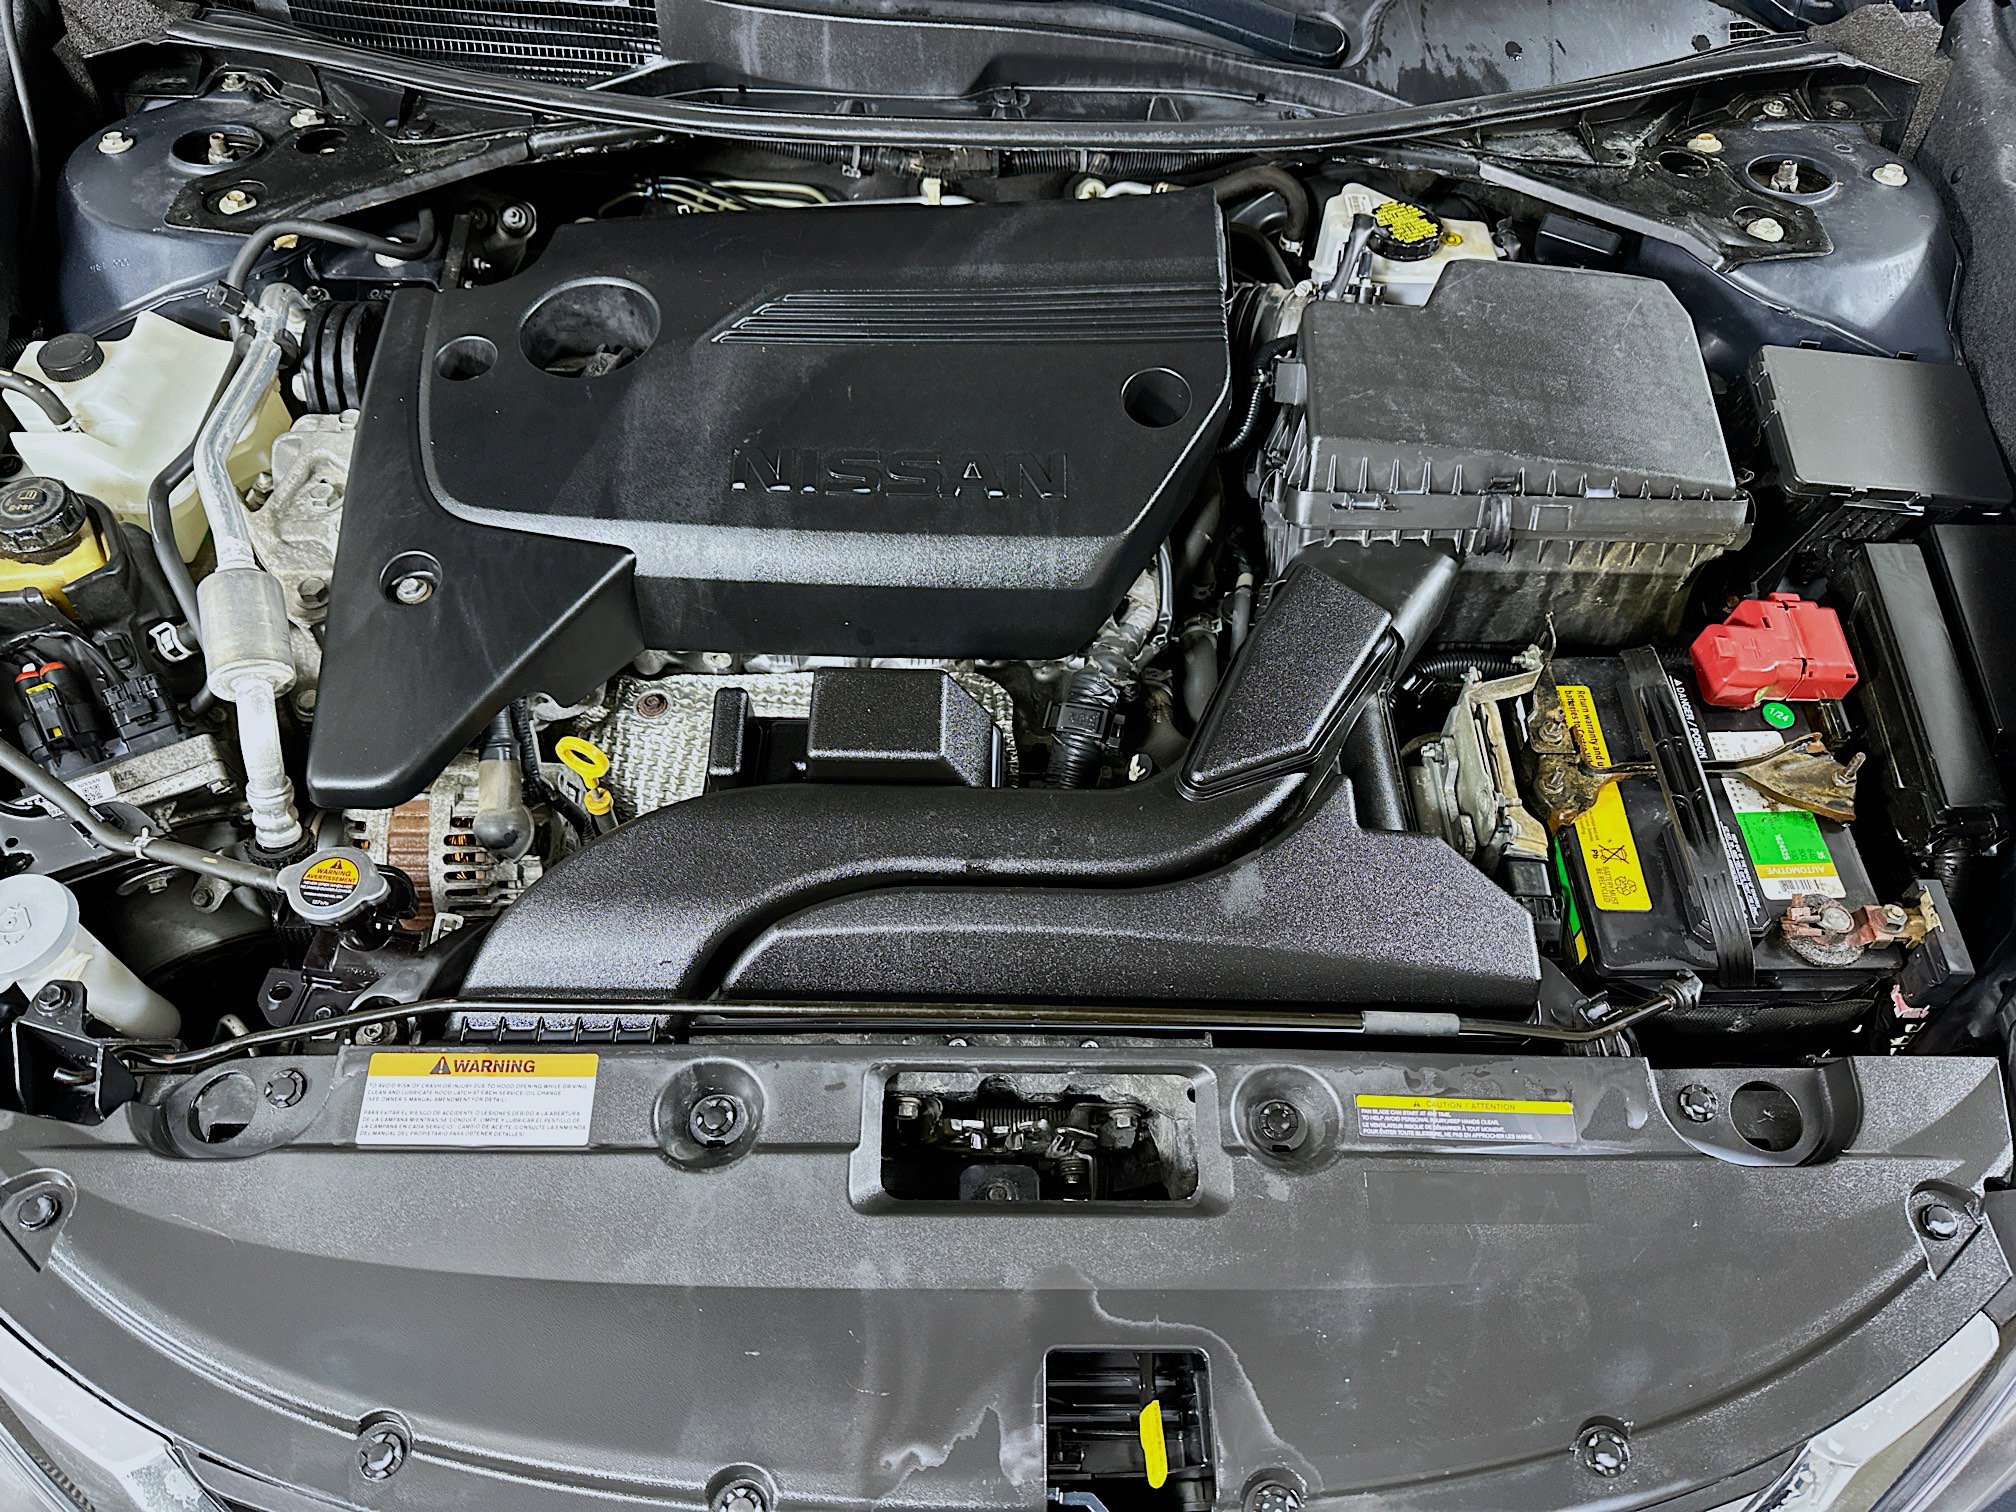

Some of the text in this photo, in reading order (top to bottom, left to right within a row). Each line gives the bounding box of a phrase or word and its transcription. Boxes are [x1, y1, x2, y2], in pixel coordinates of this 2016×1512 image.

[731, 449, 1069, 499] NISSAN
[1564, 690, 1578, 720] batteries
[1769, 707, 1790, 722] 1/24
[1577, 690, 1589, 713] Return
[1585, 714, 1599, 745] warranty
[1593, 746, 1606, 760] and
[1676, 687, 1695, 721] DANGER
[1690, 728, 1708, 760] POISON
[1591, 849, 1599, 859] Pb
[306, 873, 356, 883] AVERTISSEMENT
[317, 868, 352, 877] WARNING
[1765, 866, 1825, 875] AUTOMOTIVE
[1595, 867, 1611, 903] BE RECYCLED
[1602, 866, 1619, 905] BATTERY MUST
[454, 1059, 536, 1073] WARNING
[1426, 1101, 1462, 1109] CAUTION
[1471, 1103, 1516, 1111] ATTENTION
